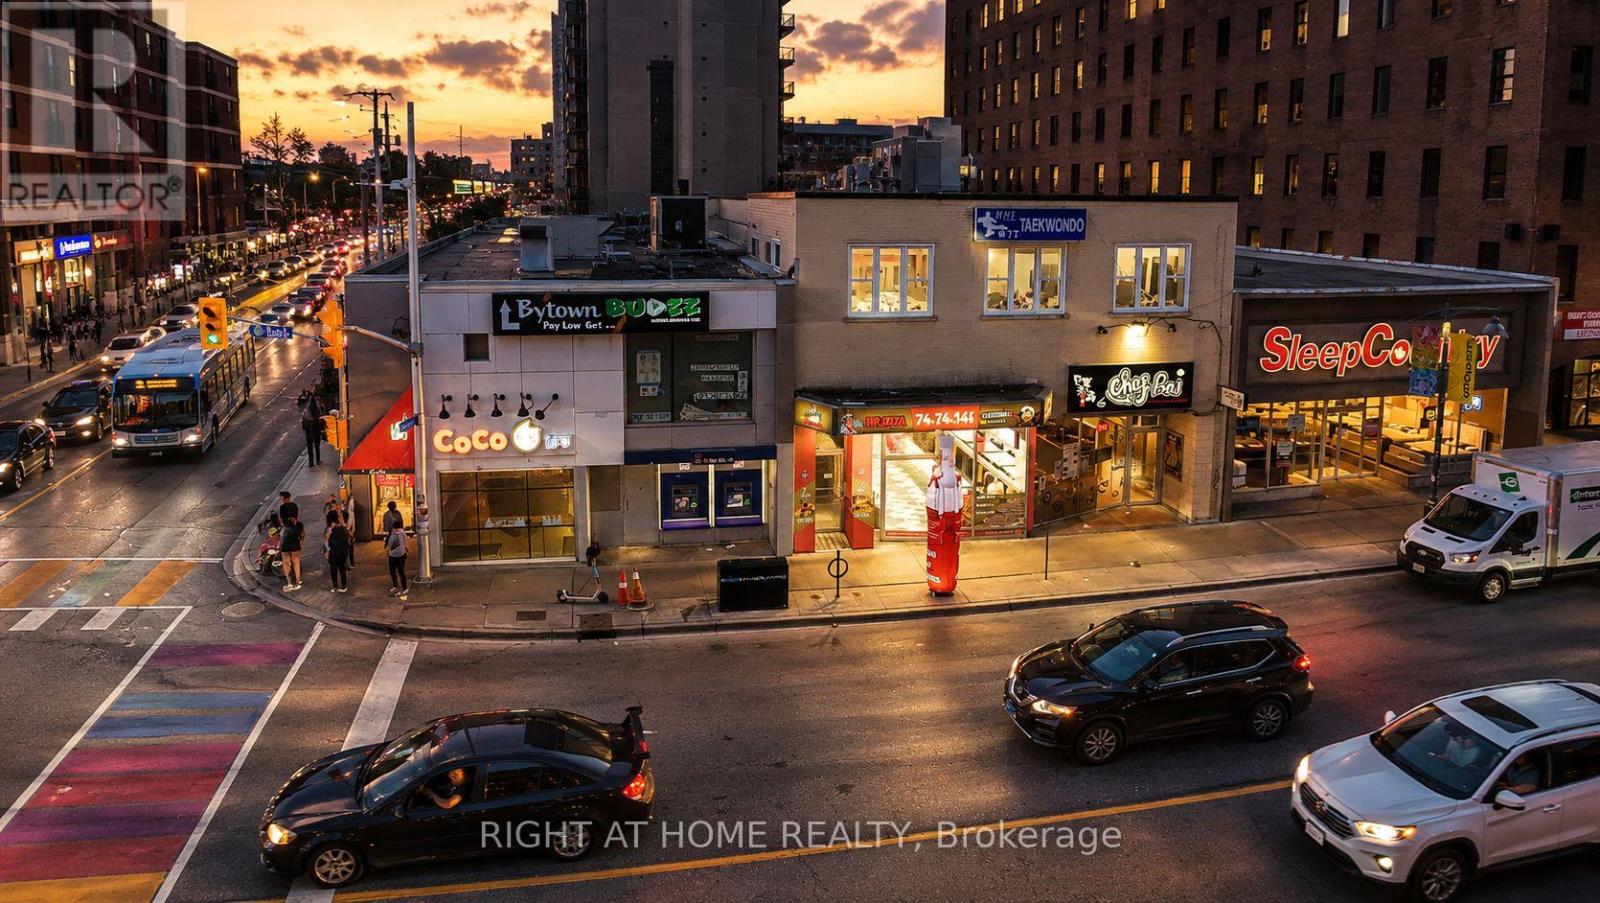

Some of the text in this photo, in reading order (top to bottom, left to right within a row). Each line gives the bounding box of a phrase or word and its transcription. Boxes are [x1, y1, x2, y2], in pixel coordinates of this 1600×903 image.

[1019, 218, 1084, 232] TAEKWONDO
[516, 299, 601, 323] Bytown
[562, 320, 581, 330] Low
